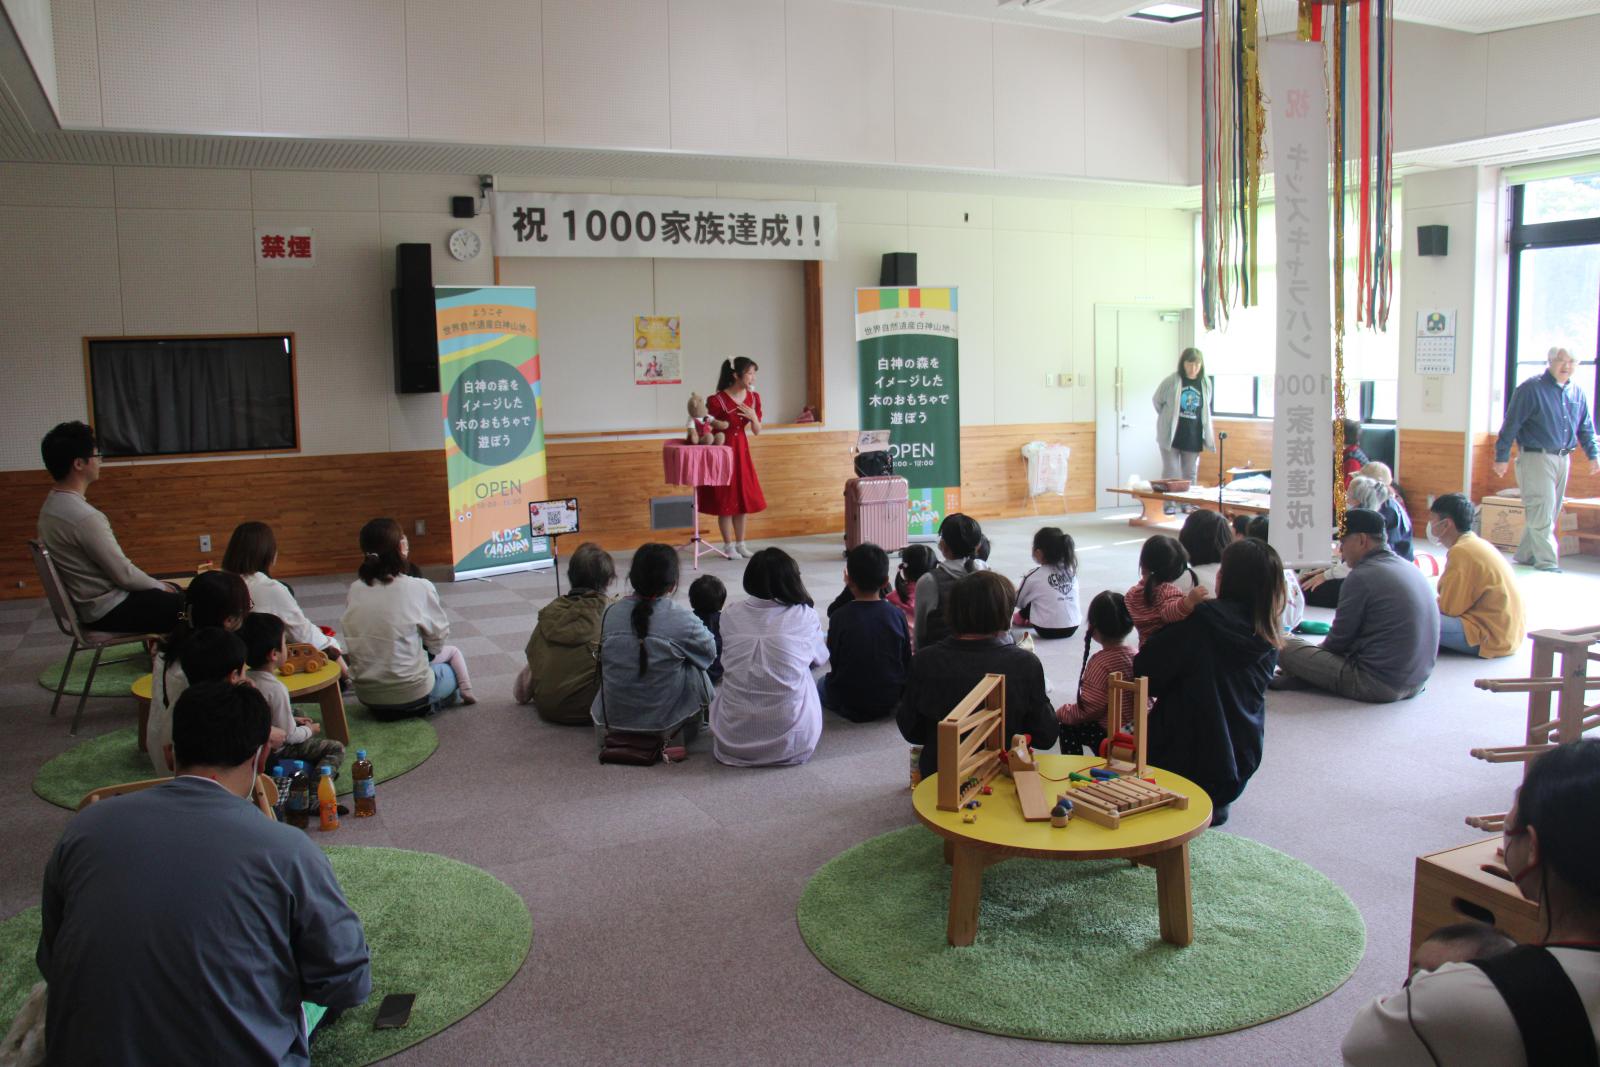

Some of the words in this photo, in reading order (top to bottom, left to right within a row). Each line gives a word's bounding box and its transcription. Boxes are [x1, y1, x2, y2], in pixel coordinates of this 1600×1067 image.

[512, 207, 548, 242] 祝
[261, 234, 312, 259] 禁煙
[473, 307, 503, 317] ようこそ
[878, 357, 940, 371] 白神の森を
[464, 379, 519, 394] 白神の森を
[875, 374, 943, 389] イメージした
[463, 396, 523, 412] イメージした
[869, 394, 949, 408] 木のおもちゃで
[456, 416, 531, 432] 木のおもちゃで
[890, 411, 927, 425] 遊ぼう
[478, 434, 511, 449] 遊ぼう
[886, 442, 935, 459] OPEN
[475, 480, 522, 499] OPEN
